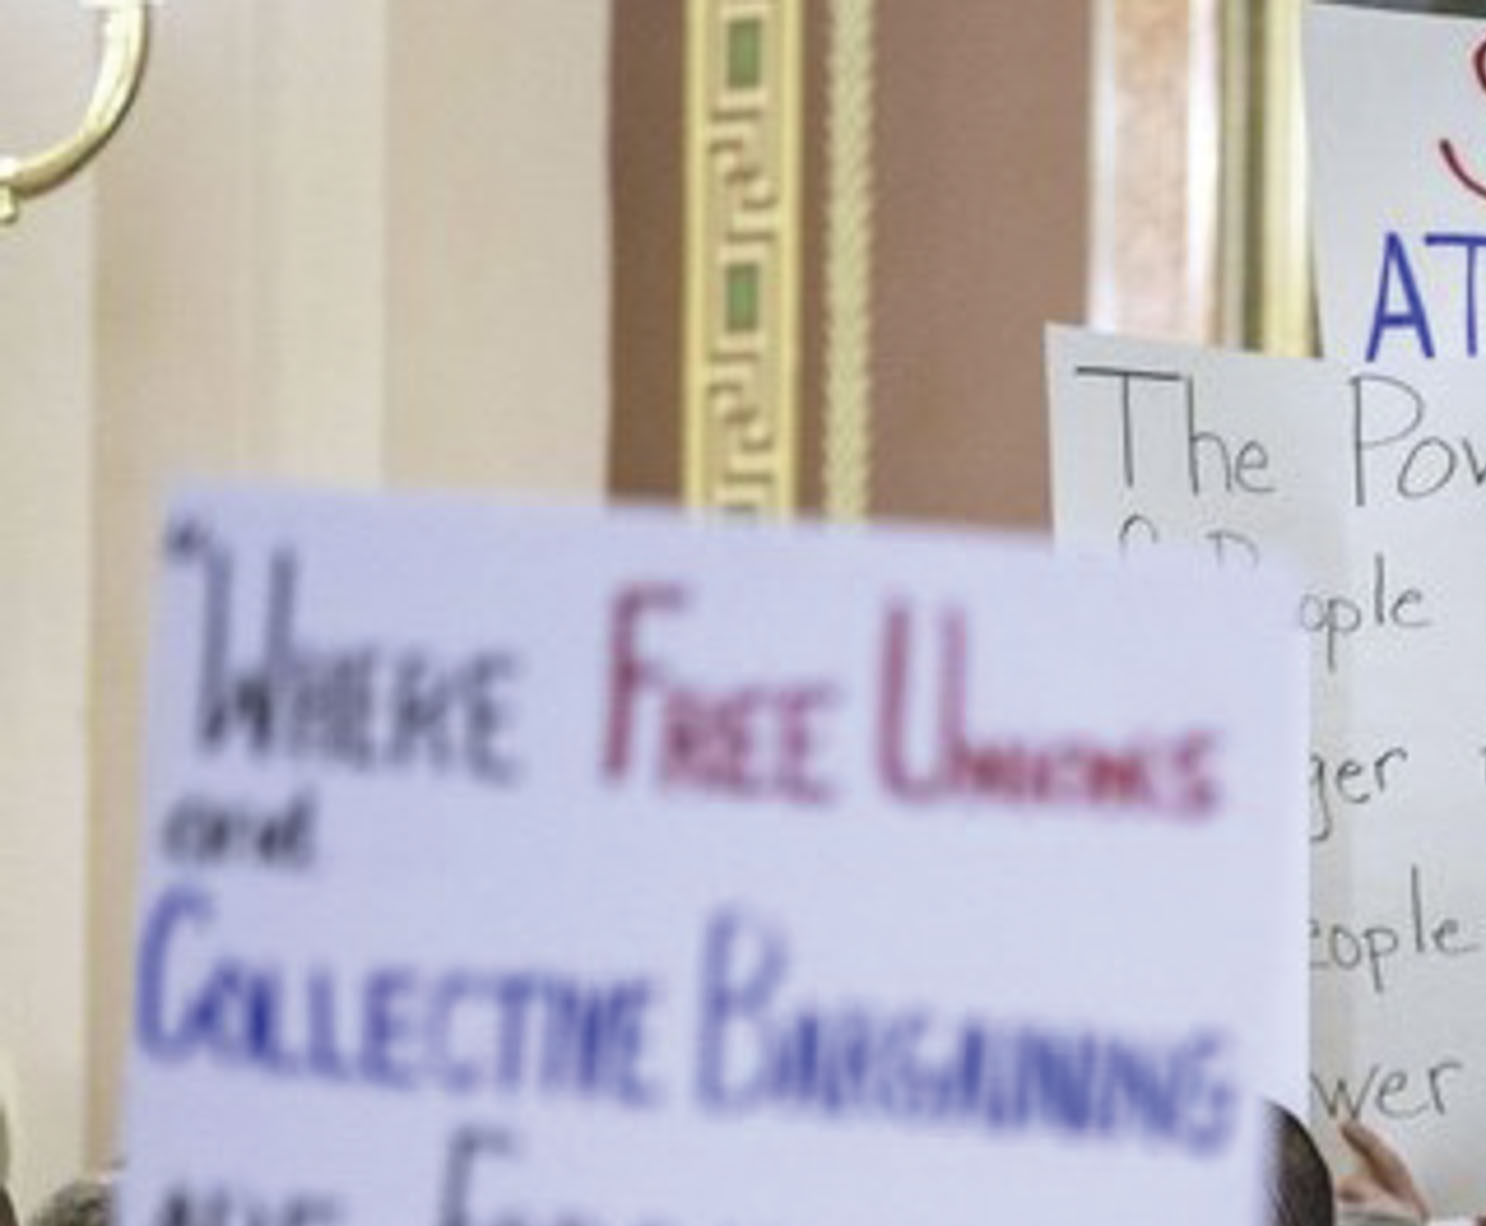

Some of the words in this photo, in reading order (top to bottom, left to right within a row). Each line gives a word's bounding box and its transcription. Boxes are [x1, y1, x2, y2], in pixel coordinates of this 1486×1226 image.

[1074, 365, 1278, 497] The
[598, 580, 842, 805] FREE
[162, 788, 320, 870] and
[1308, 863, 1480, 995] eople
